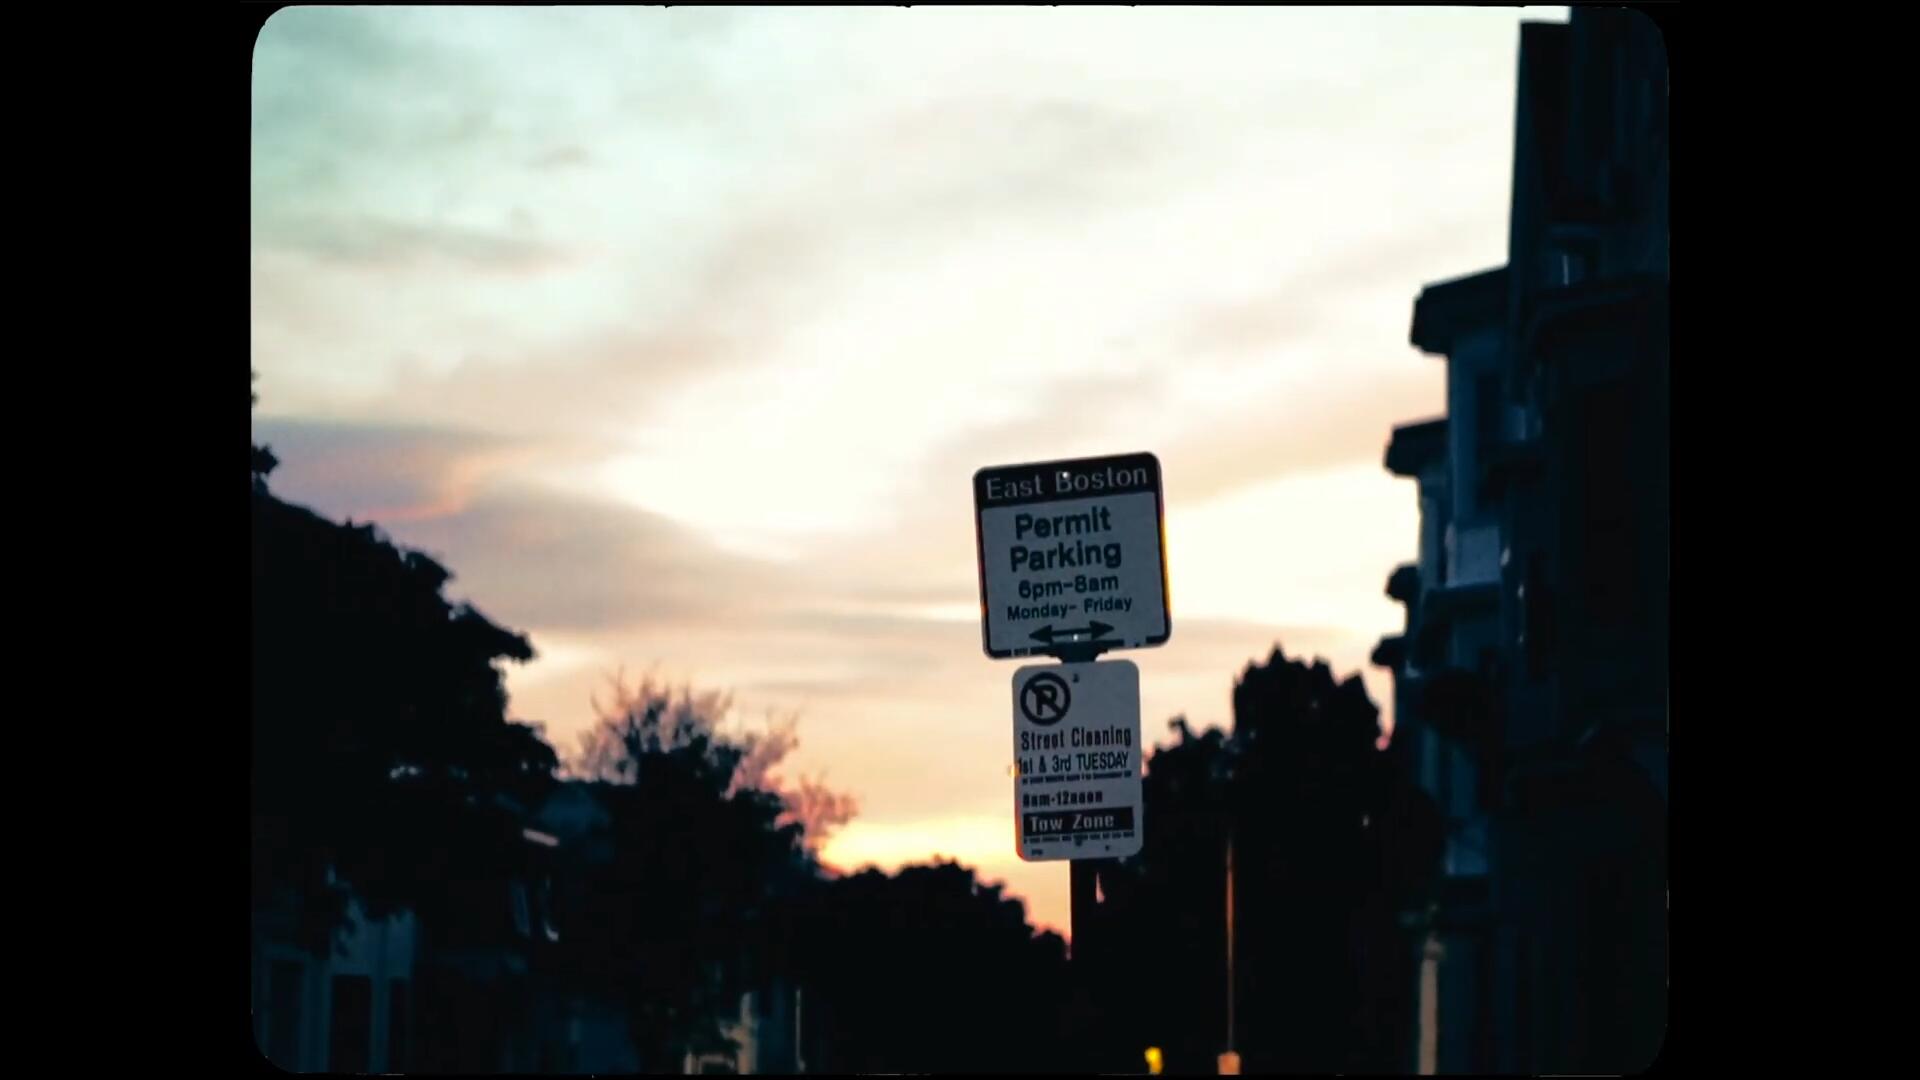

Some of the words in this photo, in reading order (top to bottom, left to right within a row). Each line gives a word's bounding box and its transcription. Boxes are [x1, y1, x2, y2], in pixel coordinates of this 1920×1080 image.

[986, 475, 1043, 499] East
[1056, 467, 1148, 493] Boston
[1016, 506, 1111, 539] Permit
[1010, 540, 1121, 571] Parking
[1019, 575, 1119, 600] 6pm-8am
[1084, 596, 1132, 613] Friday
[1021, 728, 1064, 751] Street
[1072, 724, 1132, 747] Cleaning
[1052, 754, 1071, 772] 3rd
[1076, 751, 1128, 769] TUESDAY
[1029, 816, 1063, 832] Tow
[1072, 813, 1114, 830] Zone
